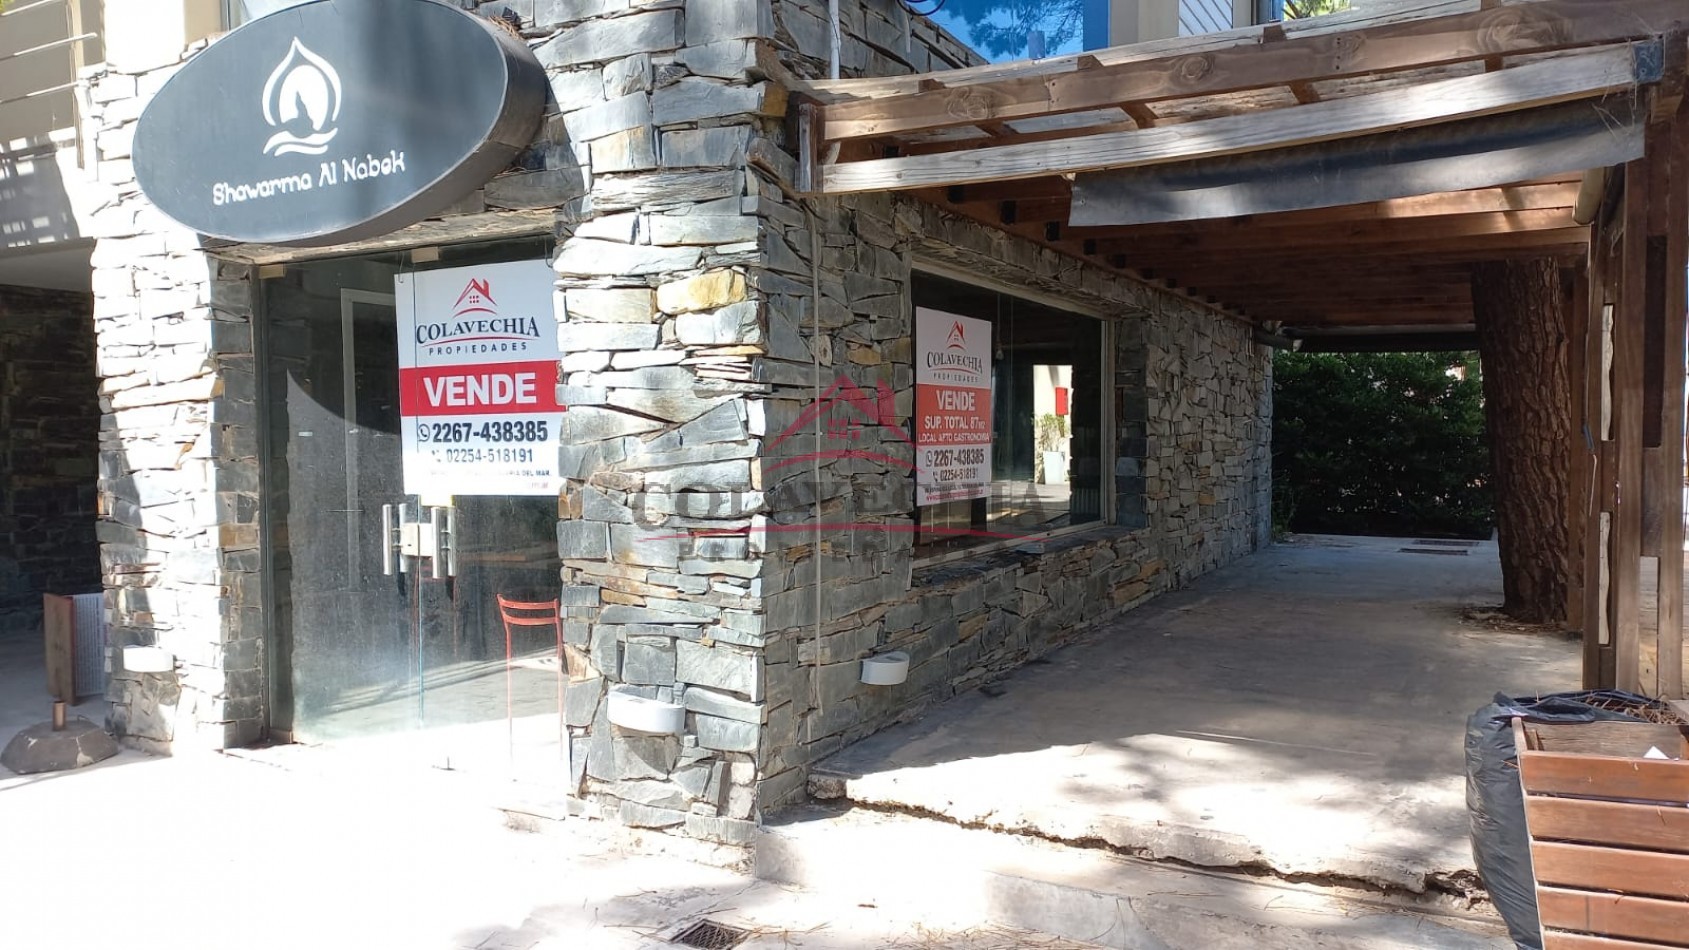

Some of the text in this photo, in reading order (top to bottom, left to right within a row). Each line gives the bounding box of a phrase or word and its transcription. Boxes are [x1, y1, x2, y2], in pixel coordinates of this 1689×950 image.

[213, 172, 312, 206] Shawarma
[319, 161, 338, 186] Al
[416, 316, 540, 344] COLAVECHIA
[429, 342, 527, 356] PROPIEDADES
[927, 351, 983, 374] COLAVECHIA
[934, 372, 979, 383] PROPIEDADES
[423, 372, 537, 407] VENDE
[936, 389, 976, 411] VENDE
[432, 420, 548, 443] 2267-438385
[924, 415, 942, 430] SUP.
[944, 416, 969, 430] TOTAL
[919, 433, 937, 443] LOCAL
[939, 433, 953, 442] APTO
[446, 448, 533, 463] 02254-518191
[934, 449, 985, 467] 2267-438385
